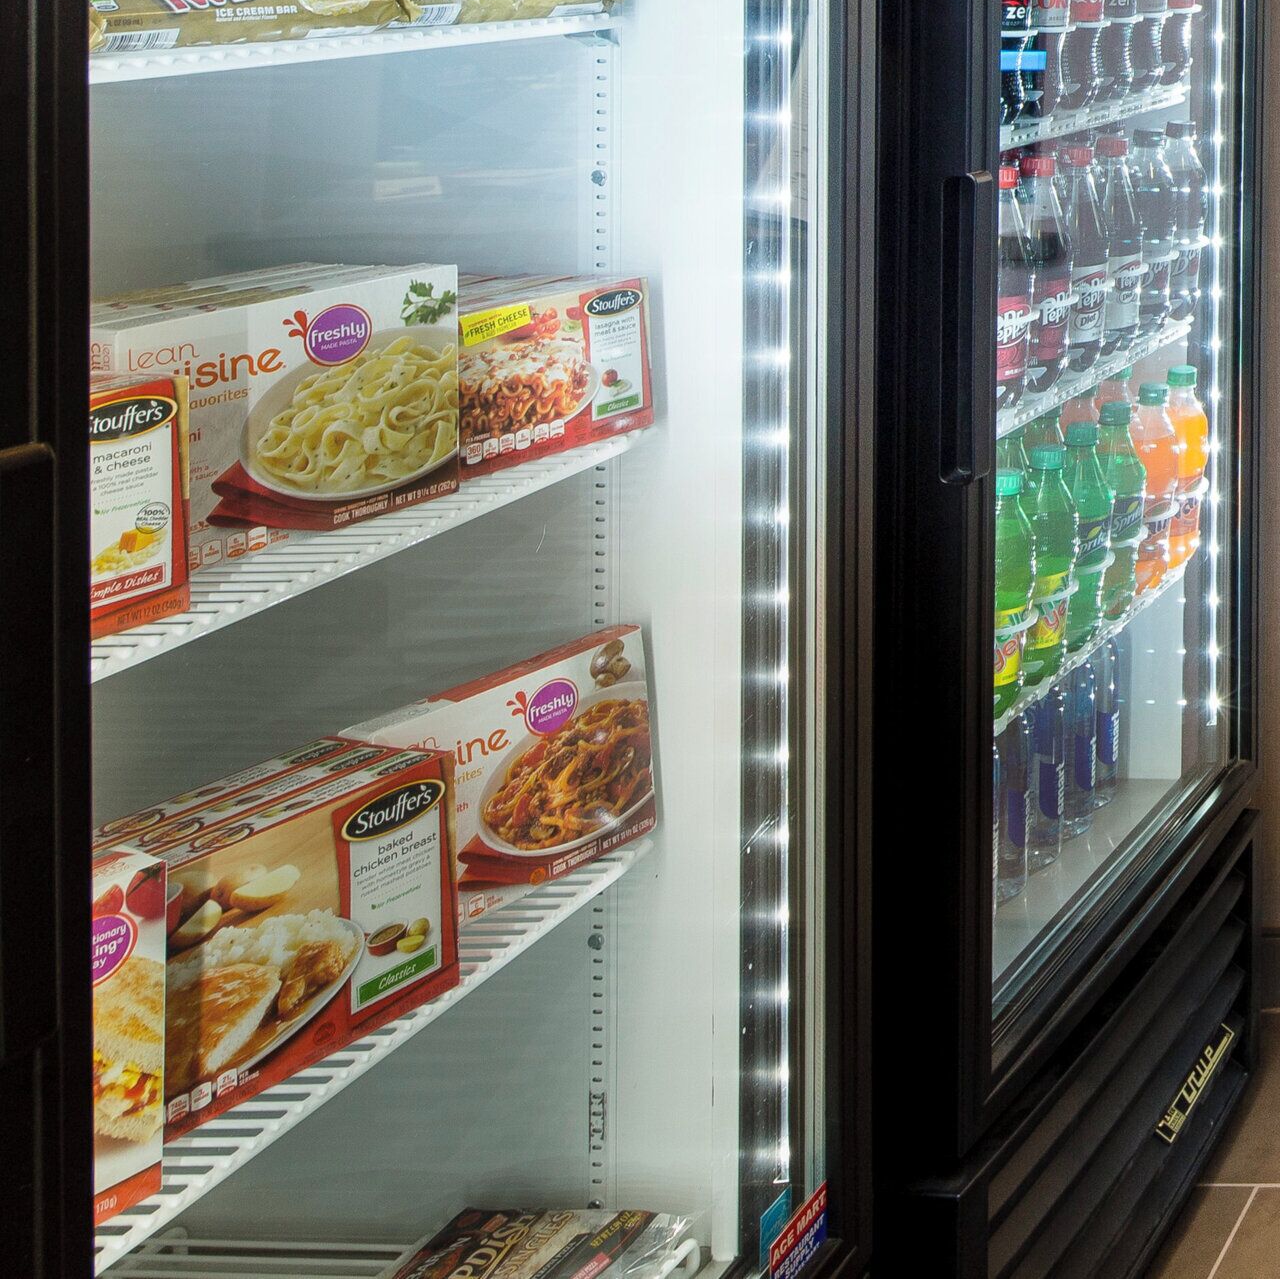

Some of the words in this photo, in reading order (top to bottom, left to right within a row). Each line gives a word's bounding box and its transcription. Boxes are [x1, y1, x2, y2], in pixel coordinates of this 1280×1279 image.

[216, 8, 233, 19] ICE
[236, 6, 274, 18] CREAM
[276, 4, 298, 15] BAR
[591, 291, 636, 314] Stouffer's
[311, 320, 366, 350] freshly
[470, 321, 496, 338] FRESH
[497, 308, 528, 326] CHEESE
[320, 341, 337, 351] MADE
[338, 338, 357, 349] PASTA
[128, 343, 199, 372] lean
[92, 441, 152, 465] macaroni
[467, 444, 481, 456] 360
[106, 455, 151, 473] cheese
[333, 510, 350, 524] COOK
[351, 499, 389, 518] THOROUGHLY
[395, 494, 408, 505] NET
[124, 571, 159, 589] Dishes
[530, 691, 575, 721] freshly
[355, 784, 432, 834] Stouffer's
[353, 851, 398, 878] chicken
[401, 832, 438, 856] breast
[377, 831, 413, 856] baked
[378, 963, 416, 991] Classics
[796, 1190, 826, 1236] MART
